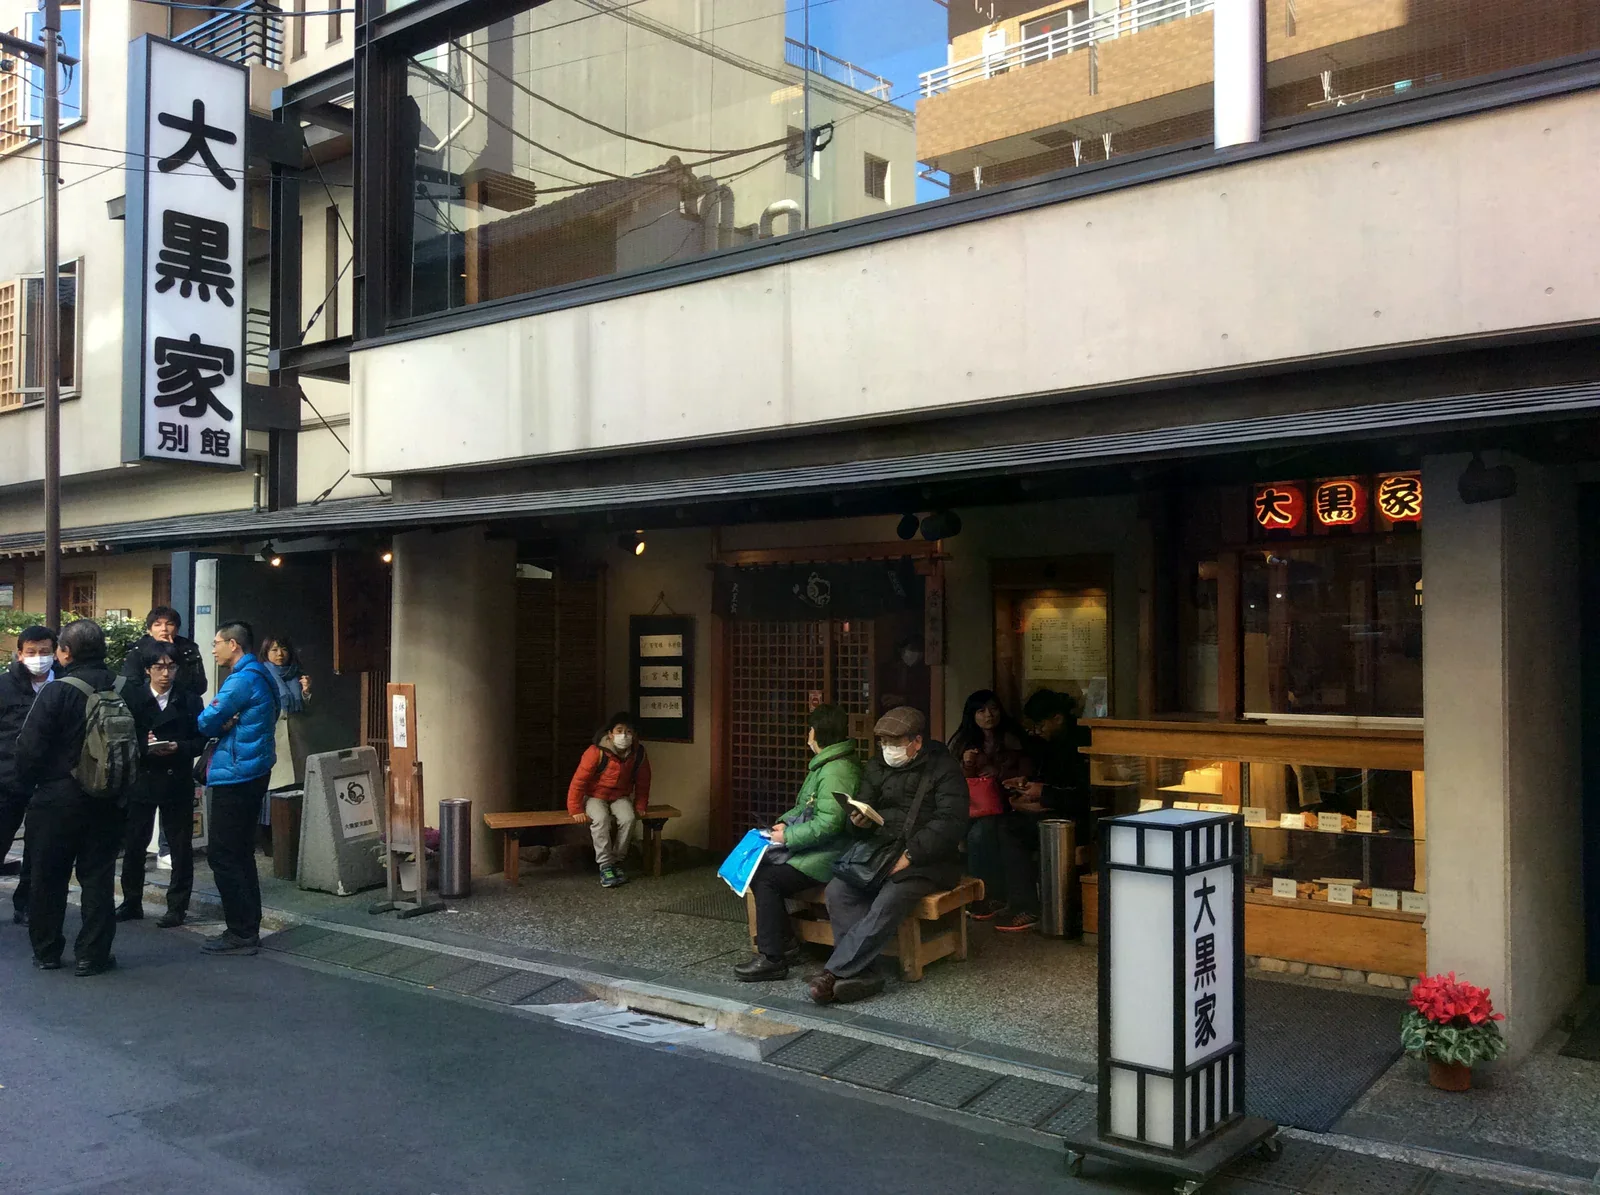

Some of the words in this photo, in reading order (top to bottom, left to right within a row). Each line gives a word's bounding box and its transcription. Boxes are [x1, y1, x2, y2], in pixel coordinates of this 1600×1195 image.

[154, 98, 237, 422] 大黒家
[157, 421, 230, 457] 別館
[1257, 478, 1420, 525] 大黒家
[1194, 877, 1216, 1048] 大黒家
